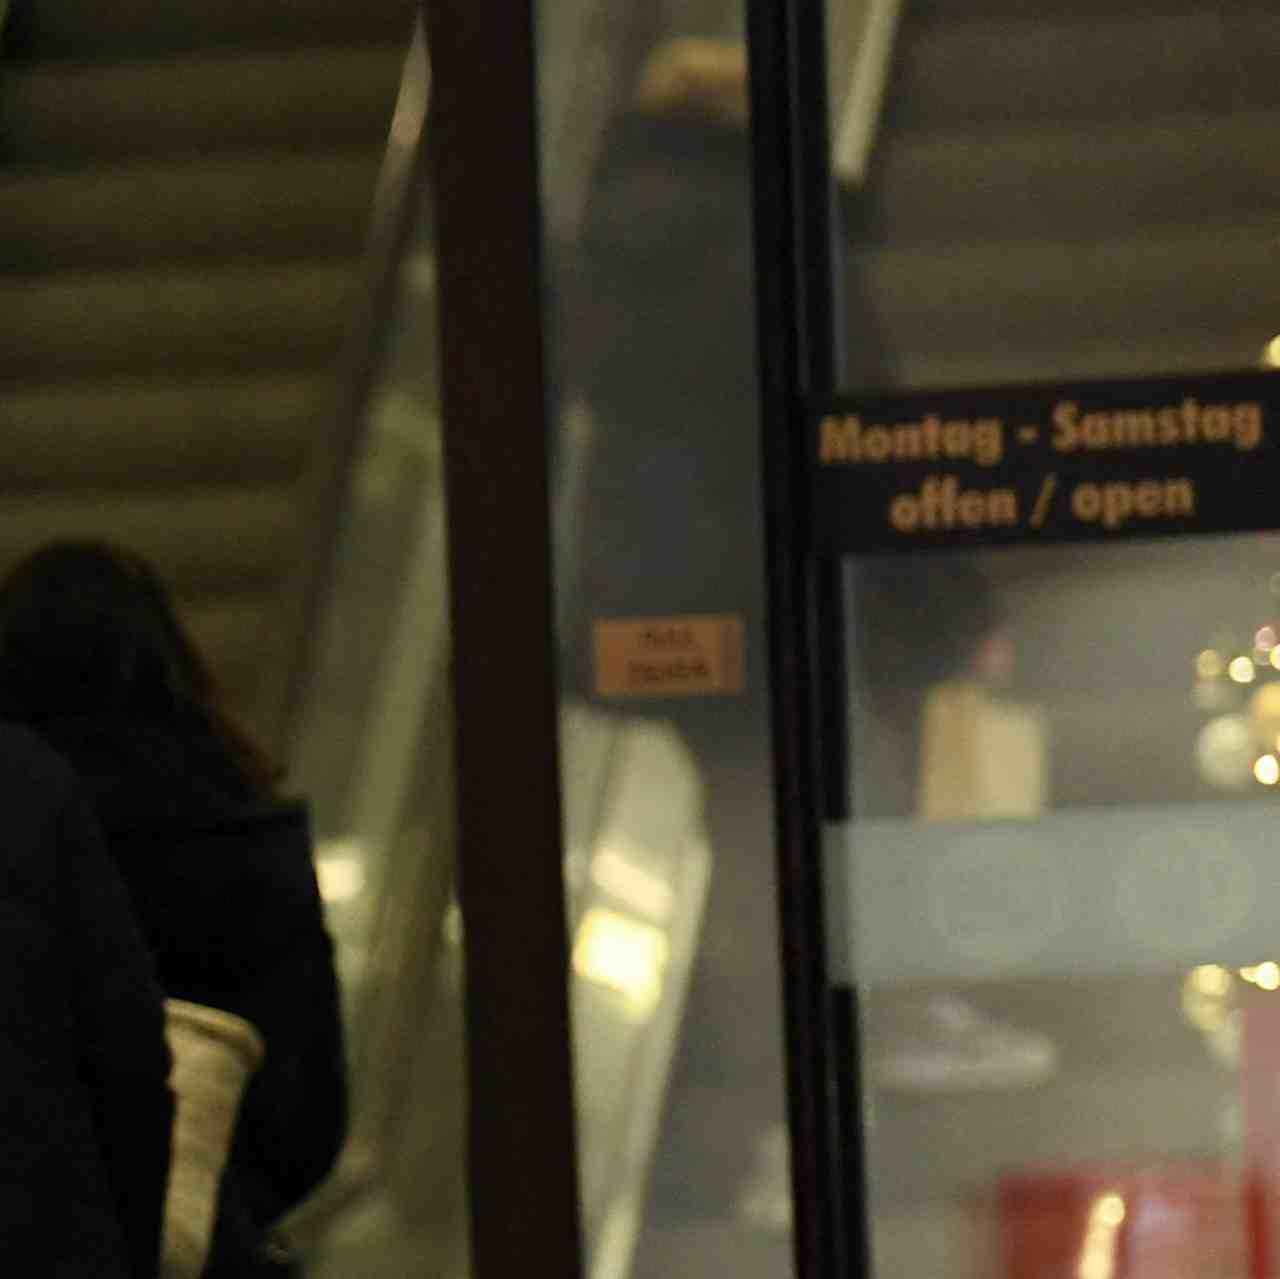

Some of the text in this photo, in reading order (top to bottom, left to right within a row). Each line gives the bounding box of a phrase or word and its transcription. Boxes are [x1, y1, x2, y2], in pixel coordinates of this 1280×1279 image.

[819, 416, 1003, 465] Montag
[1051, 399, 1262, 452] Samstag
[888, 474, 1018, 532] offen
[1072, 479, 1194, 526] open
